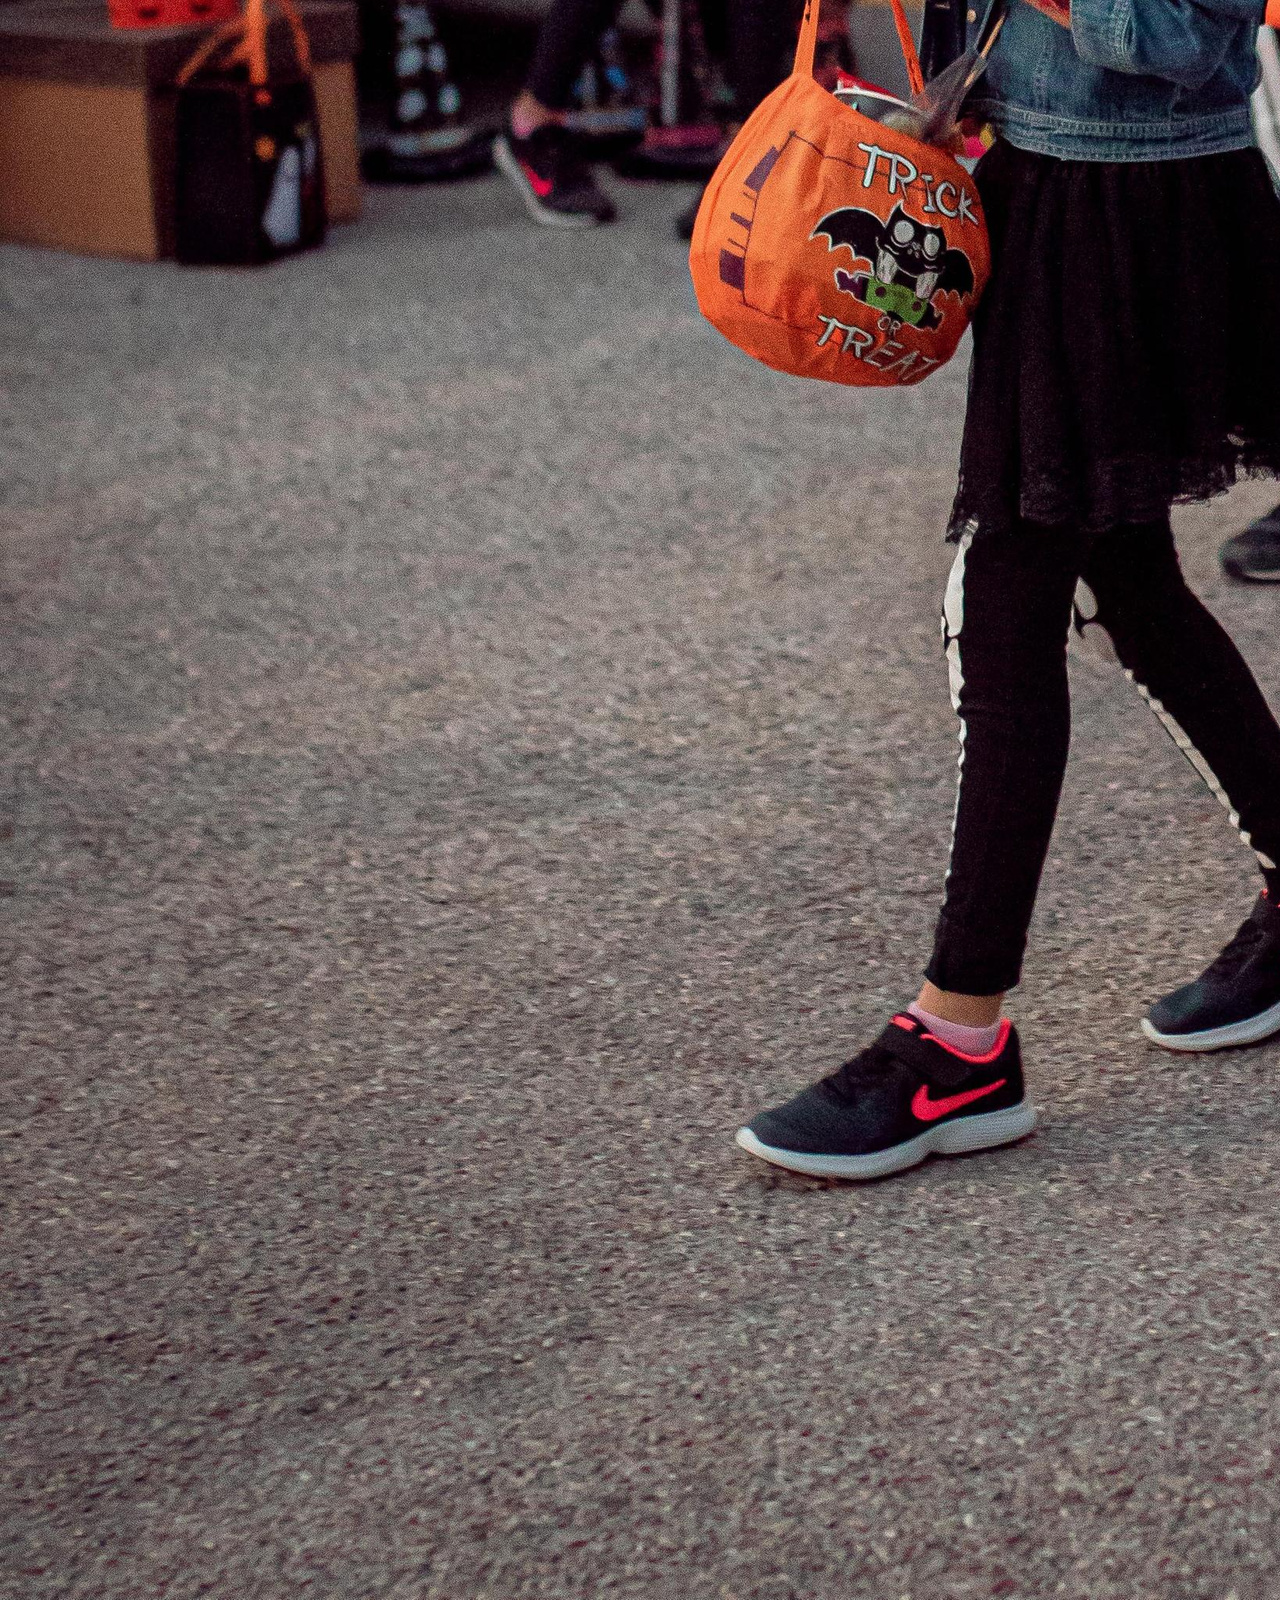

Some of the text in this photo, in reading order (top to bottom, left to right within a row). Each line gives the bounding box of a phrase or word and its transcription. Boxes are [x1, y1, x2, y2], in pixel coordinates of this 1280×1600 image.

[856, 140, 980, 225] TRICK
[816, 313, 941, 381] TREAT
[877, 315, 901, 337] OR
